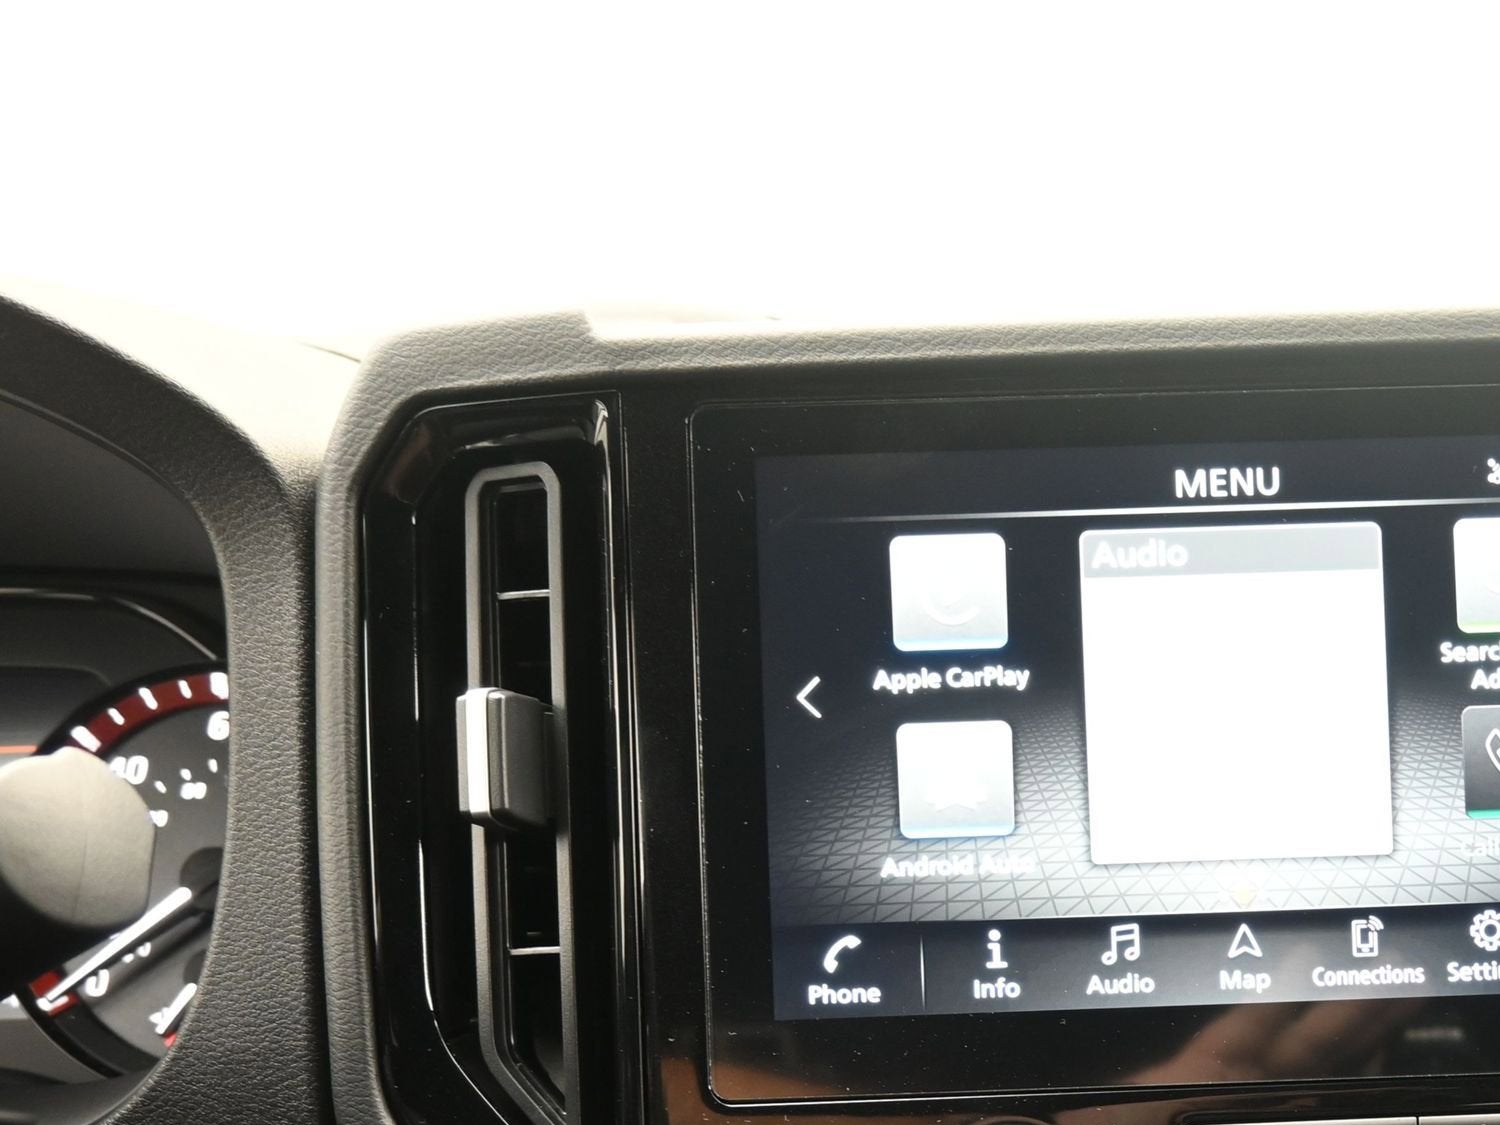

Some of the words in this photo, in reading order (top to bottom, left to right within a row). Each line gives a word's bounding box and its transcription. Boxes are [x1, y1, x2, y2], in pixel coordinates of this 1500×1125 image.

[1174, 467, 1281, 499] MENU
[1091, 537, 1189, 571] Audio
[872, 667, 941, 695] Apple
[944, 665, 1030, 692] CarPlay
[880, 855, 975, 878] Android
[973, 976, 1021, 1000] Info
[1085, 970, 1156, 996] Audio
[1218, 968, 1271, 995] Map
[1311, 965, 1425, 988] Connections
[807, 981, 881, 1007] Phone
